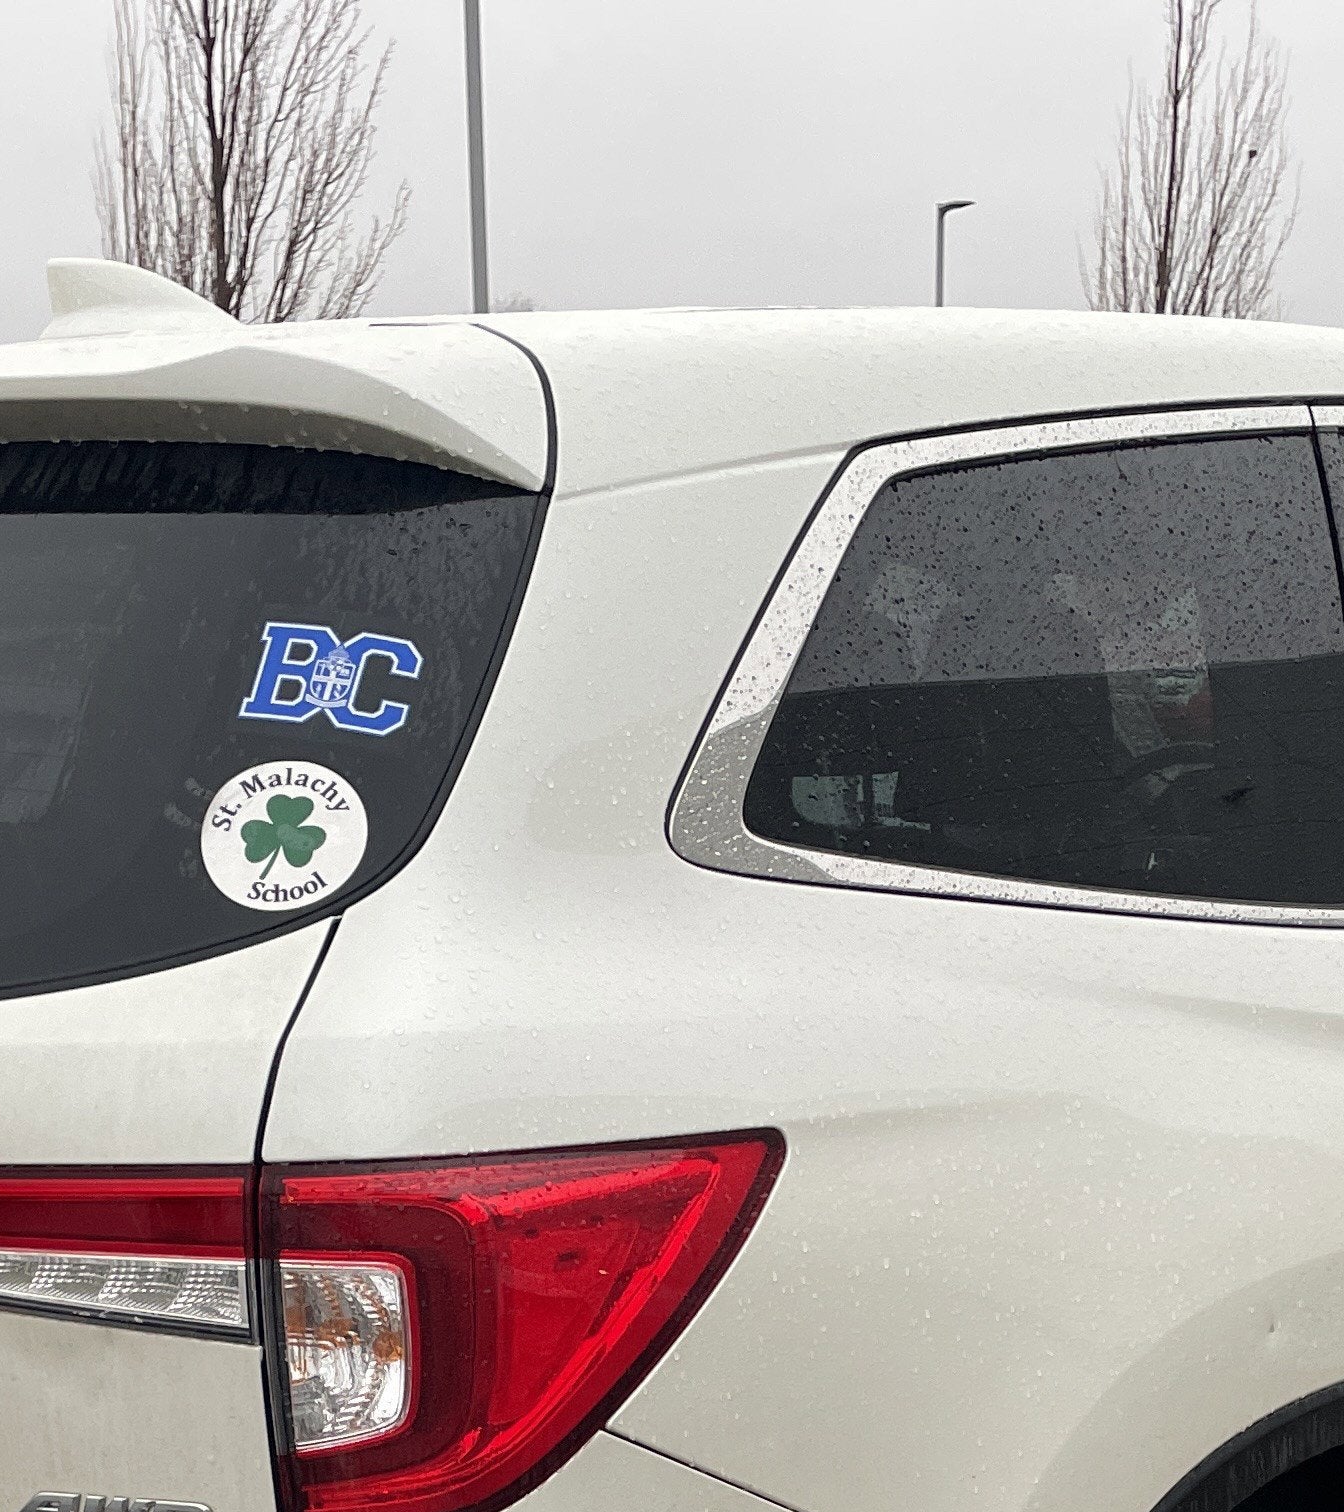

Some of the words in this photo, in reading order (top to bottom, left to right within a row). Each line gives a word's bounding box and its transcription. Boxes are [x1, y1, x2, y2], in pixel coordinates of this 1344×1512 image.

[238, 621, 424, 736] BC
[211, 801, 243, 832] St.
[240, 767, 350, 813] Malachy
[246, 871, 329, 903] School
